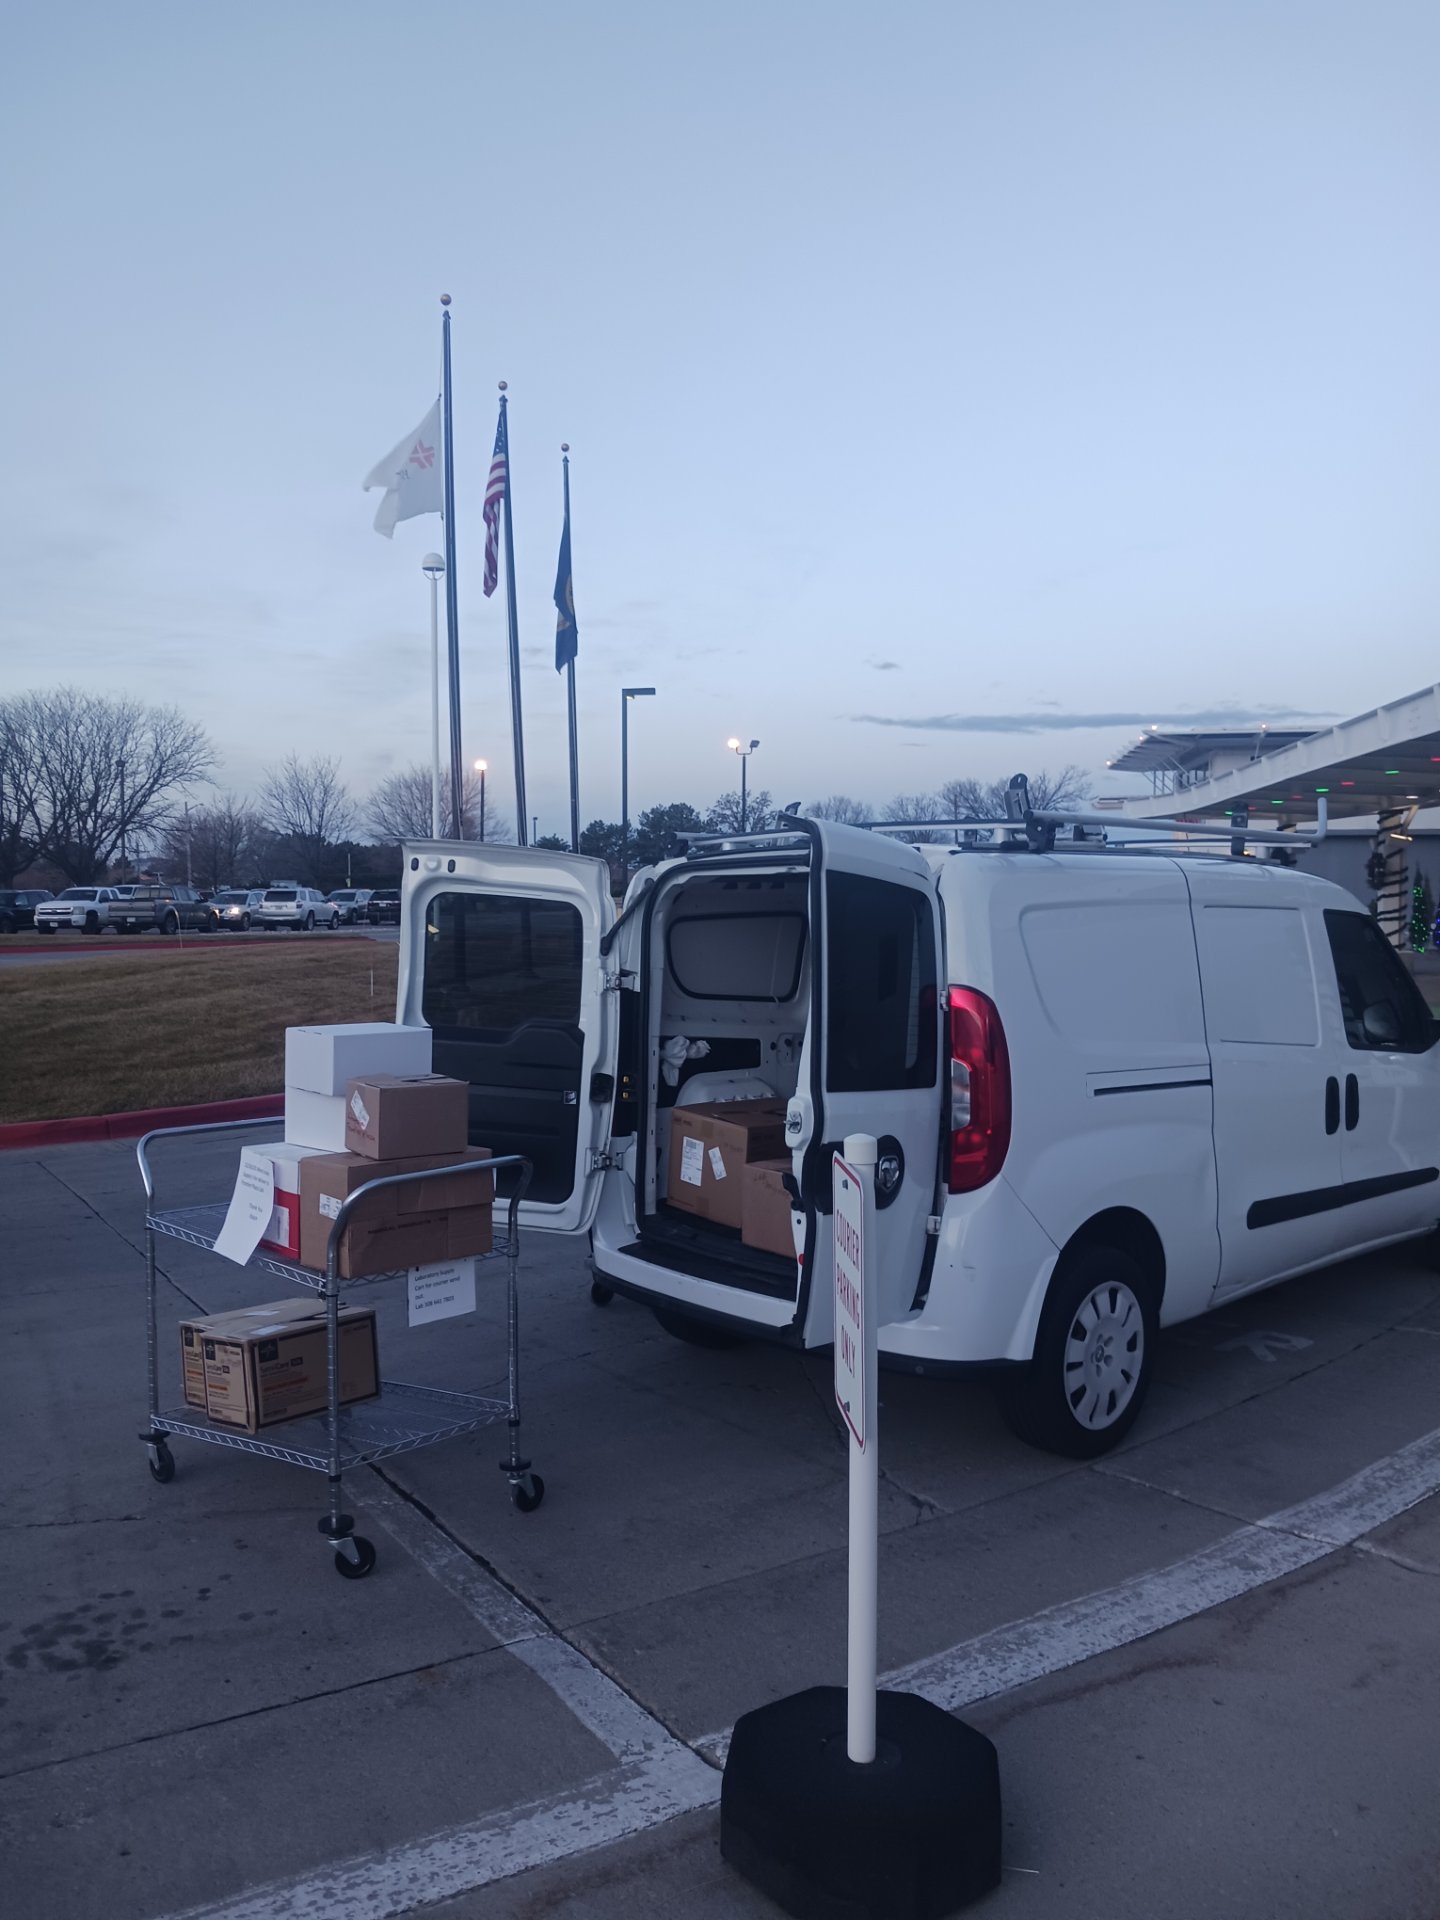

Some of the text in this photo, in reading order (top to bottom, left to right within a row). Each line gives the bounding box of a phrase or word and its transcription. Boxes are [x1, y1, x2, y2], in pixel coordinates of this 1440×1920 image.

[836, 1208, 860, 1272] COURIER
[836, 1262, 860, 1330] PARKING
[841, 1324, 856, 1379] ONLY
